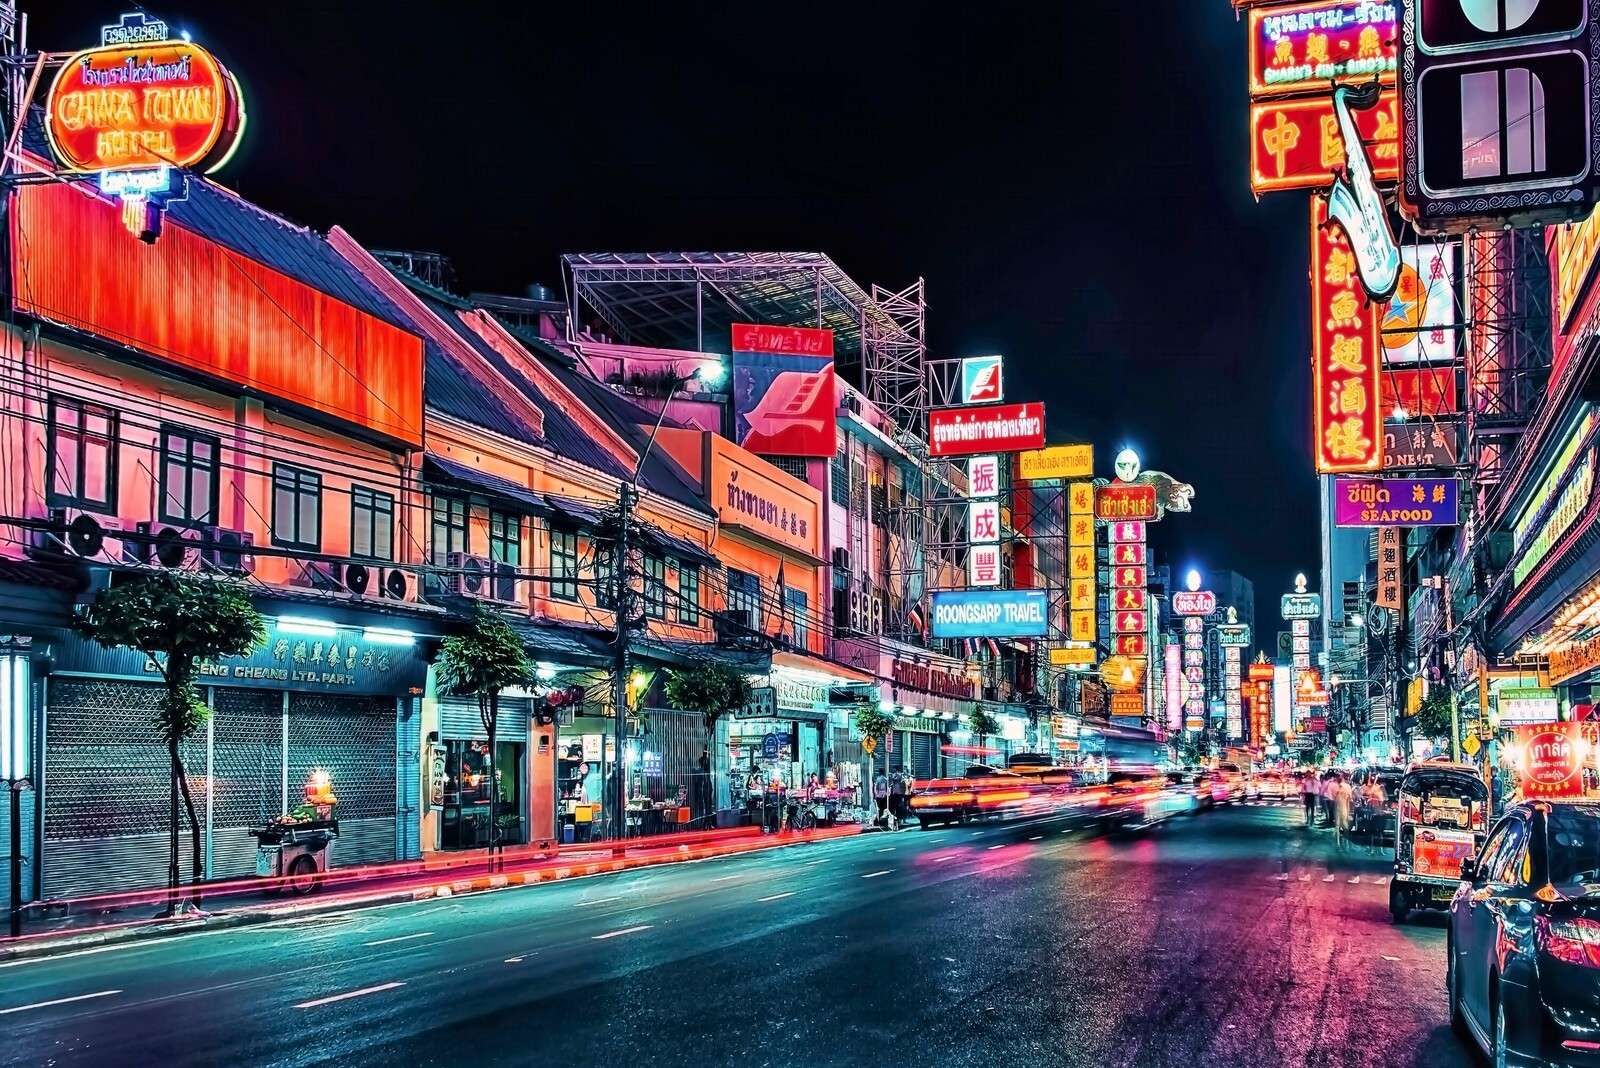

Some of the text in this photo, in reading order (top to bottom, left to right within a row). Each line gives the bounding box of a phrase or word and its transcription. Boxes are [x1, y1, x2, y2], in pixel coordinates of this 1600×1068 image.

[58, 87, 216, 128] CHINA TOWN
[96, 130, 175, 157] HOTEL
[933, 404, 1041, 452] รุ่งทรัพย์การท่องเที่ยว
[1412, 484, 1446, 504] 海鮮
[972, 463, 997, 582] 振成豐
[1360, 509, 1433, 522] SEAFOOD
[1383, 528, 1397, 602] 魚翅酒樓
[936, 602, 1044, 624] ROONGSARP TRAVEL
[234, 666, 288, 681] CHEANG
